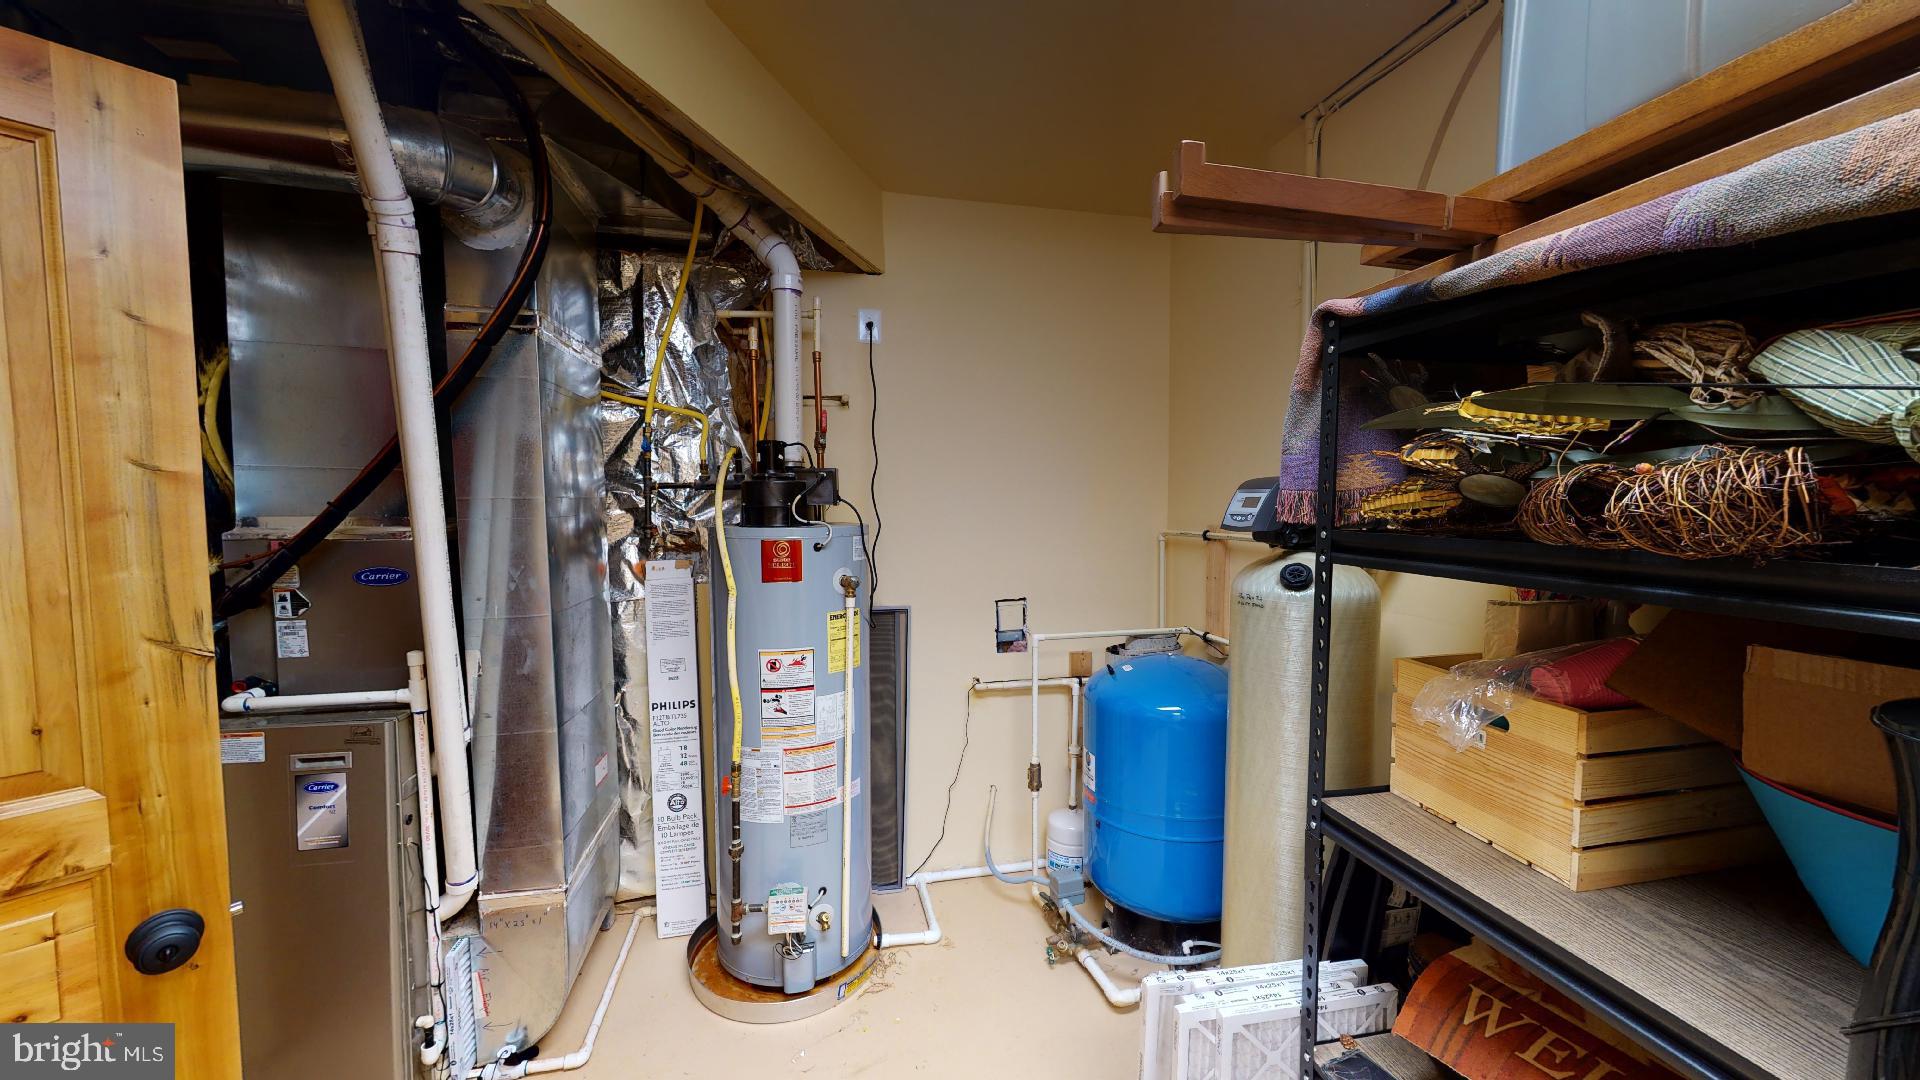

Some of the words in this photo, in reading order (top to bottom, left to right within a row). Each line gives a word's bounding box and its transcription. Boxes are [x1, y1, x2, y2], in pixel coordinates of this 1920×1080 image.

[361, 572, 402, 581] Carrier
[651, 700, 696, 711] PHILIPS
[657, 815, 665, 823] 10
[666, 814, 681, 822] Bulb
[682, 812, 698, 820] Pack
[661, 831, 669, 839] 10
